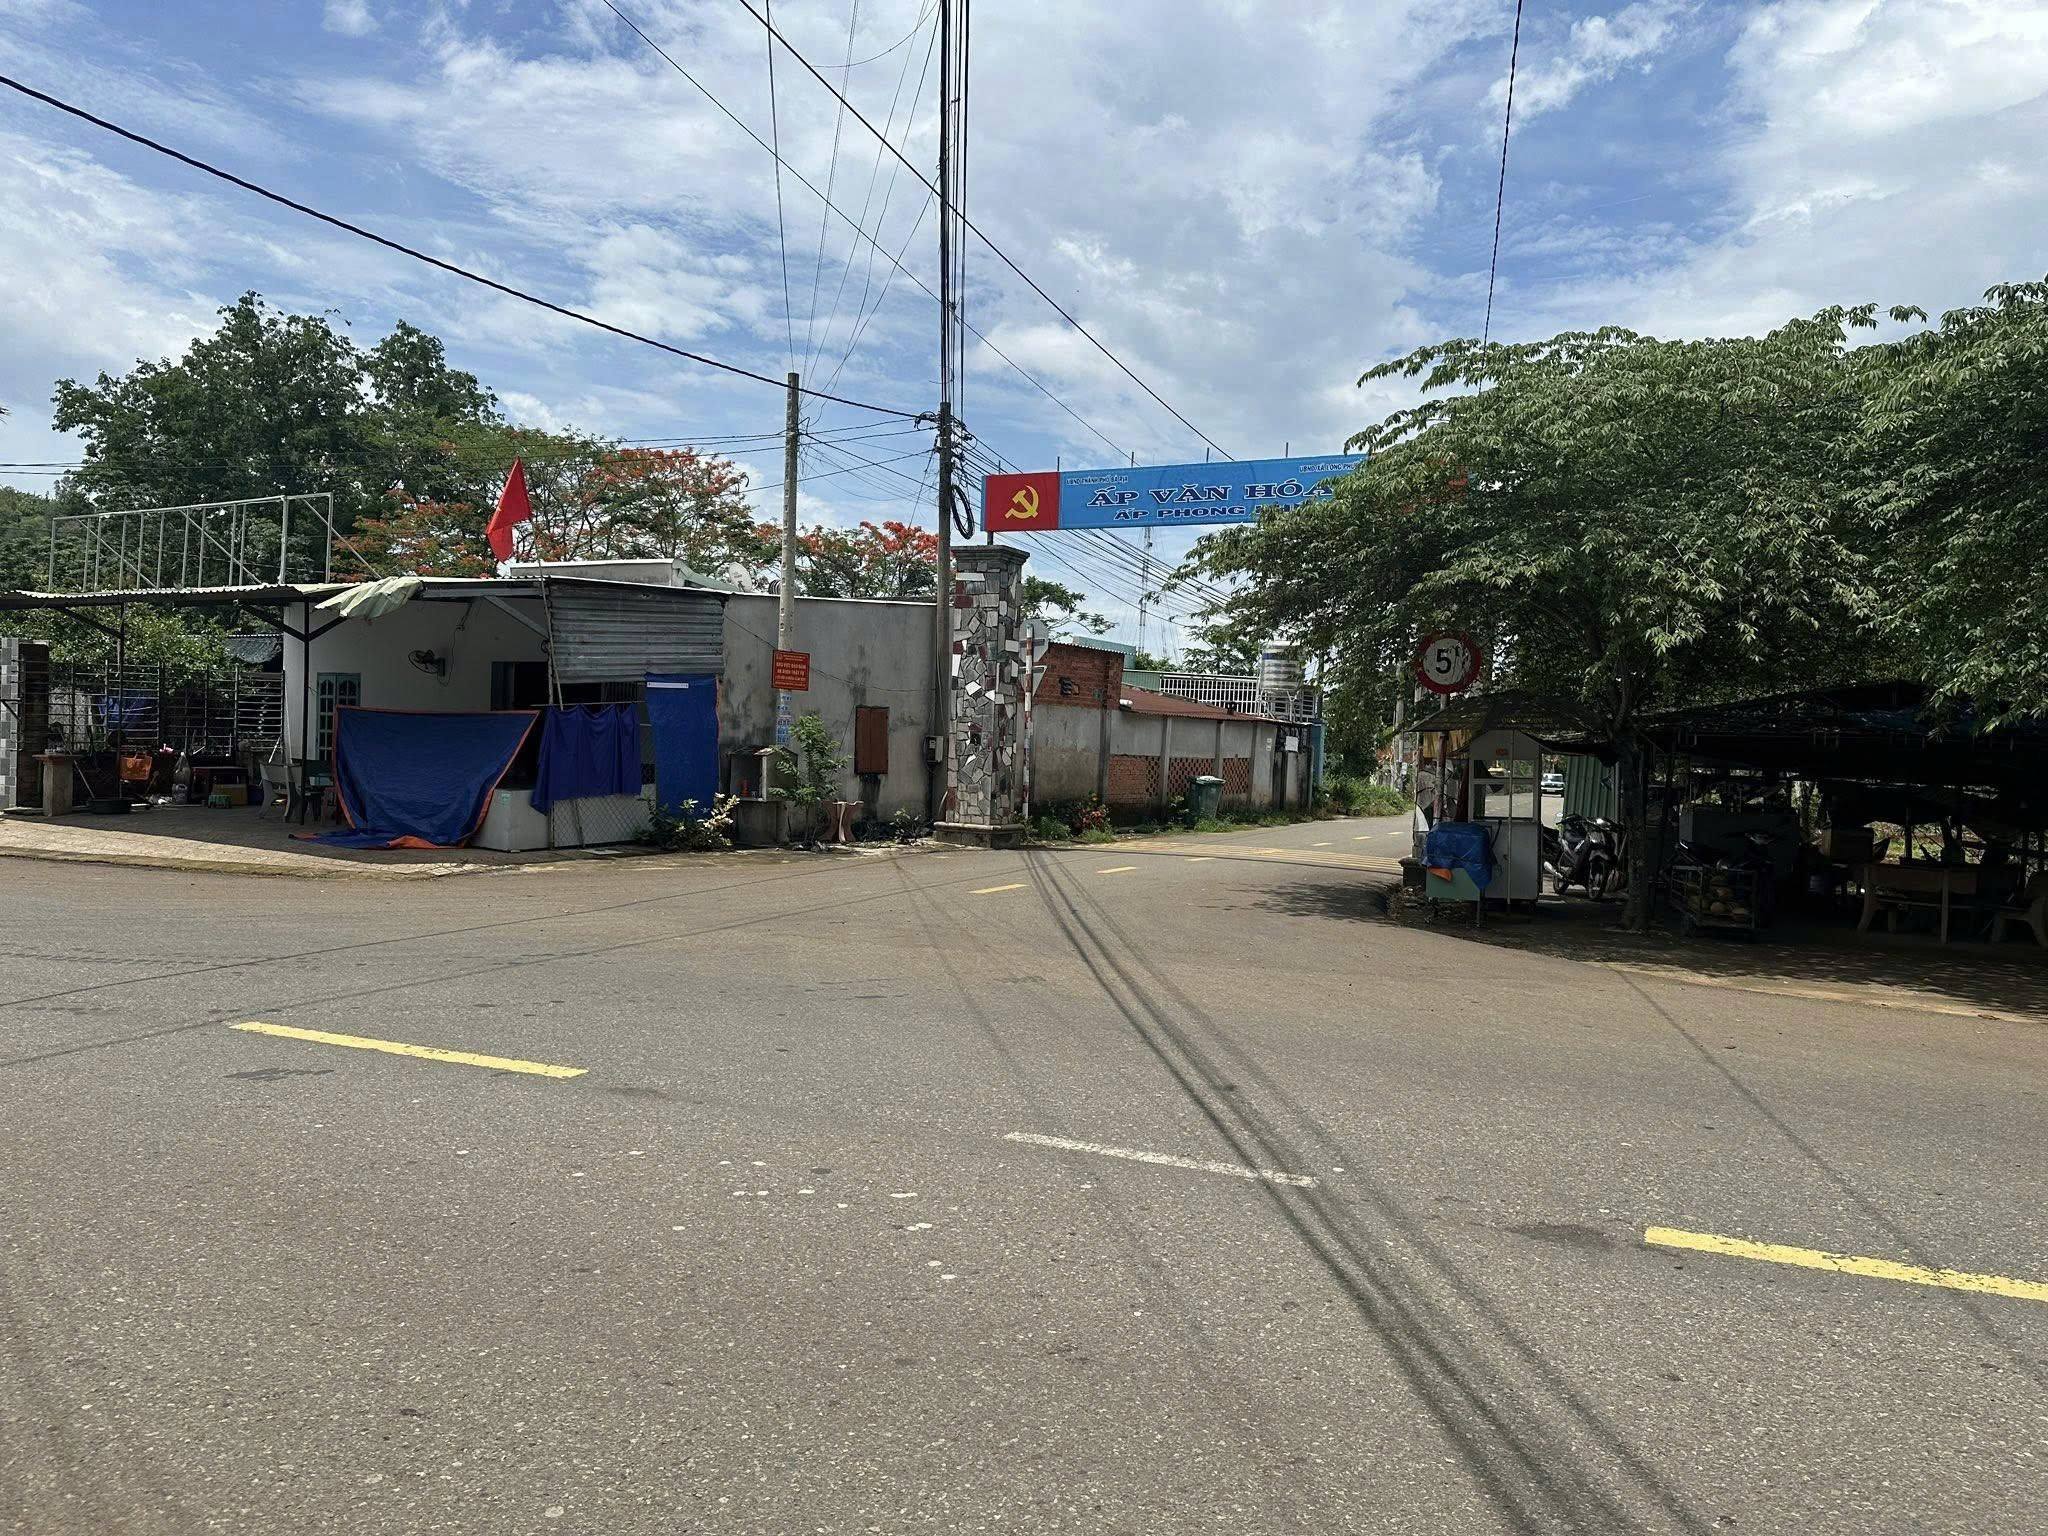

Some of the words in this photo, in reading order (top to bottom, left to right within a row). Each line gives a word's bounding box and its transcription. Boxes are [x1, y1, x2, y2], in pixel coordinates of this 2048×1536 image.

[1326, 463, 1343, 471] LONG
[1087, 485, 1140, 507] ẤP
[1149, 483, 1232, 504] VĂN
[1244, 478, 1333, 500] HÓA
[1114, 507, 1149, 520] ẤP
[1157, 506, 1245, 518] PHONG
